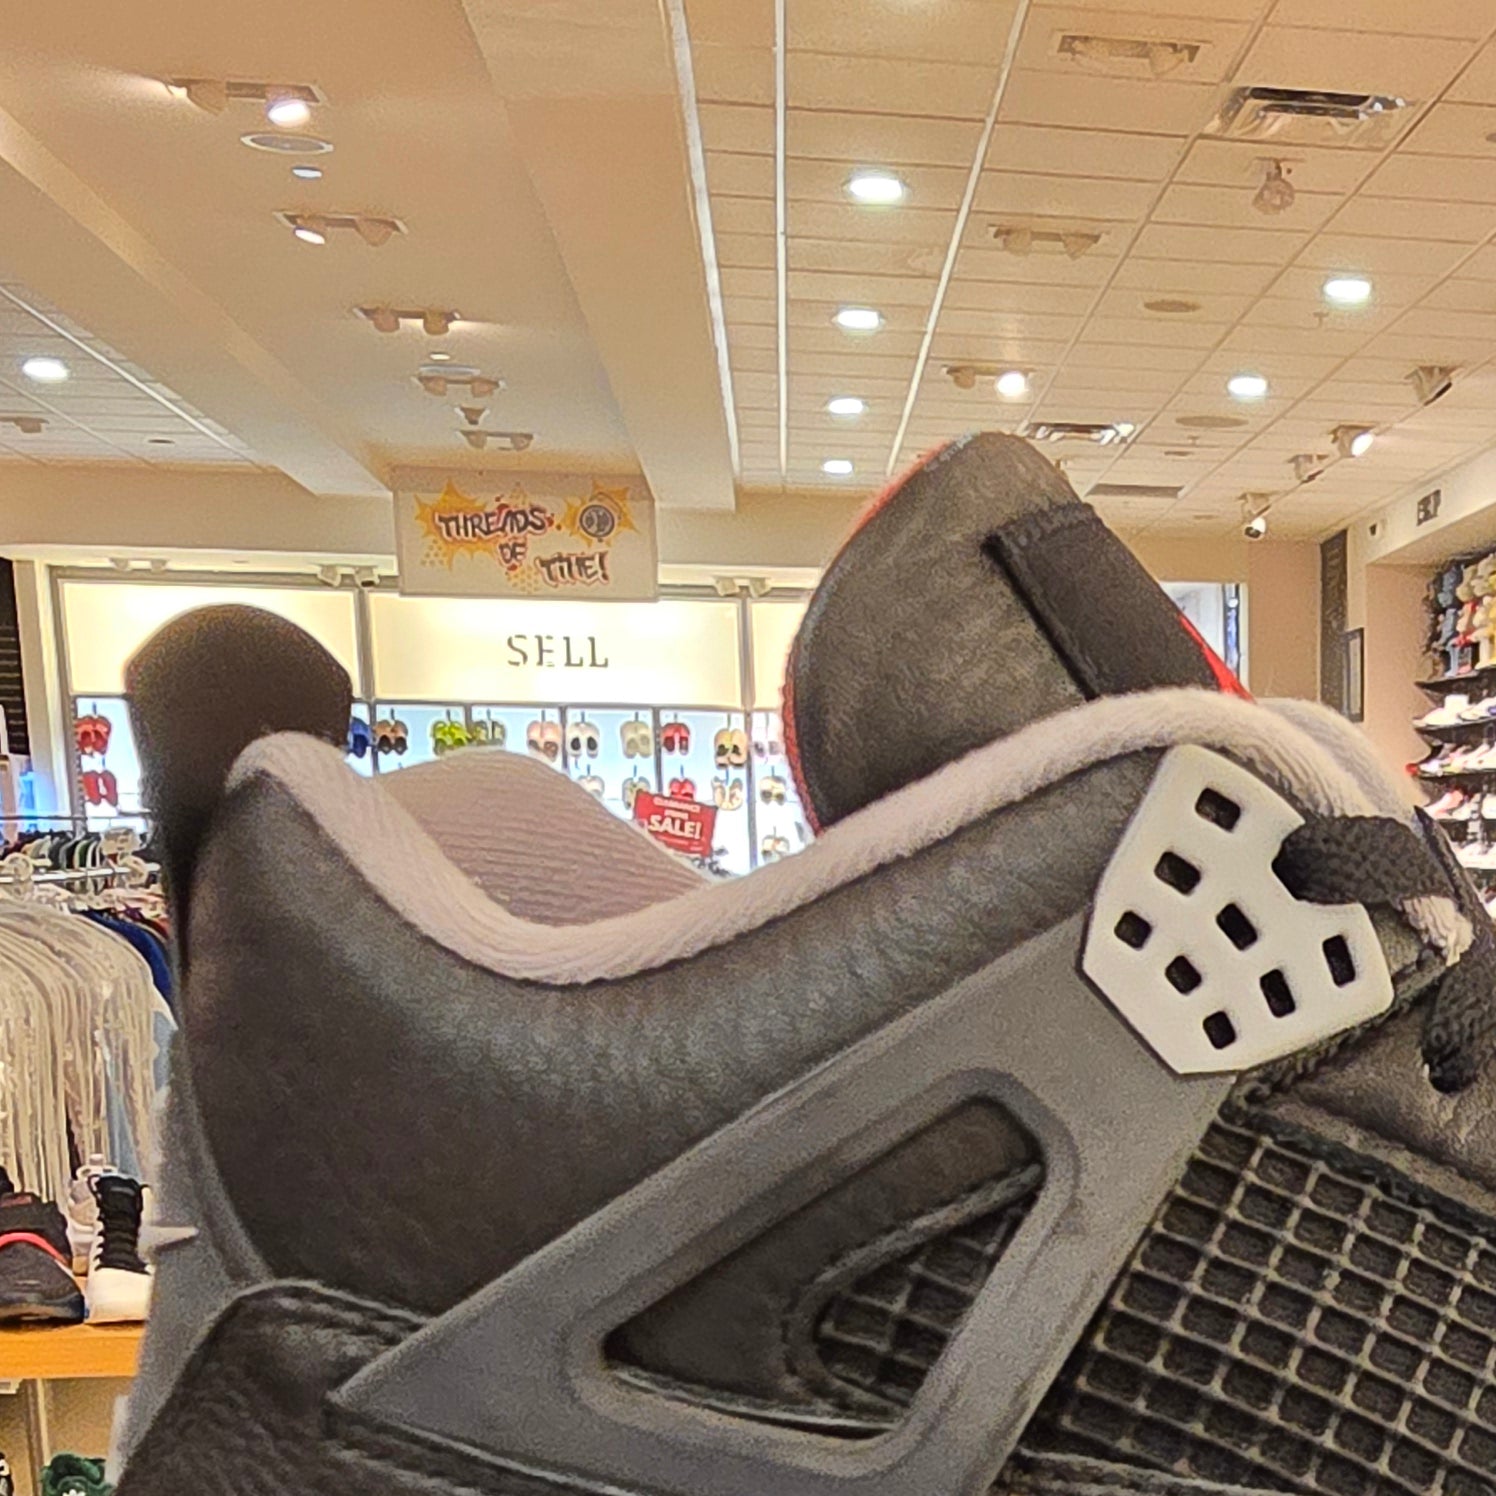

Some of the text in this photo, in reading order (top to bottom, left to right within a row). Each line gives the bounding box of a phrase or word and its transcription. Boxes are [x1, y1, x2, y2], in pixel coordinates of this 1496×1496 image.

[437, 507, 547, 538] THREADS
[507, 634, 608, 668] SELL
[648, 814, 702, 839] SALE!
